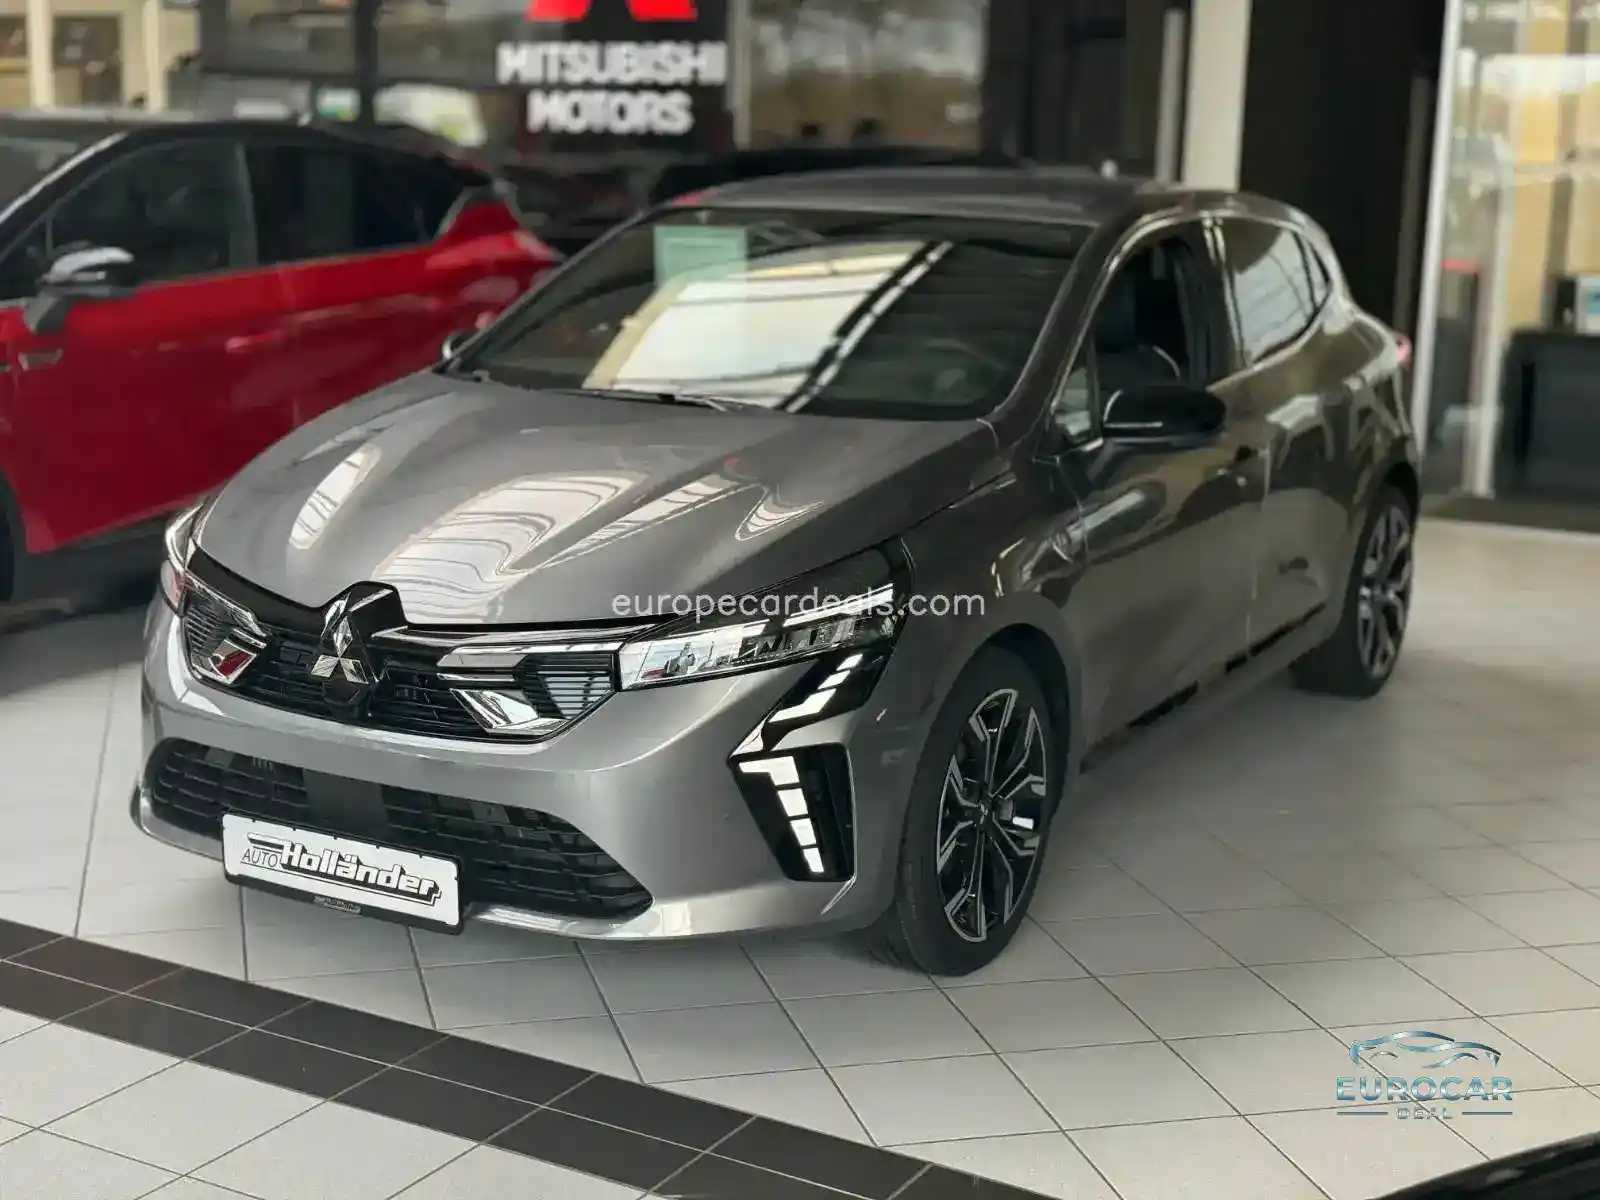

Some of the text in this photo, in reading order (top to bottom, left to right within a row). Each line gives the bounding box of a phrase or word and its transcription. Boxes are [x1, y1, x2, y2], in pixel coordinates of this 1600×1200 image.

[496, 41, 727, 84] MITSUBISHI
[527, 89, 694, 134] MOTORS
[241, 842, 441, 897] AUTO Holländer
